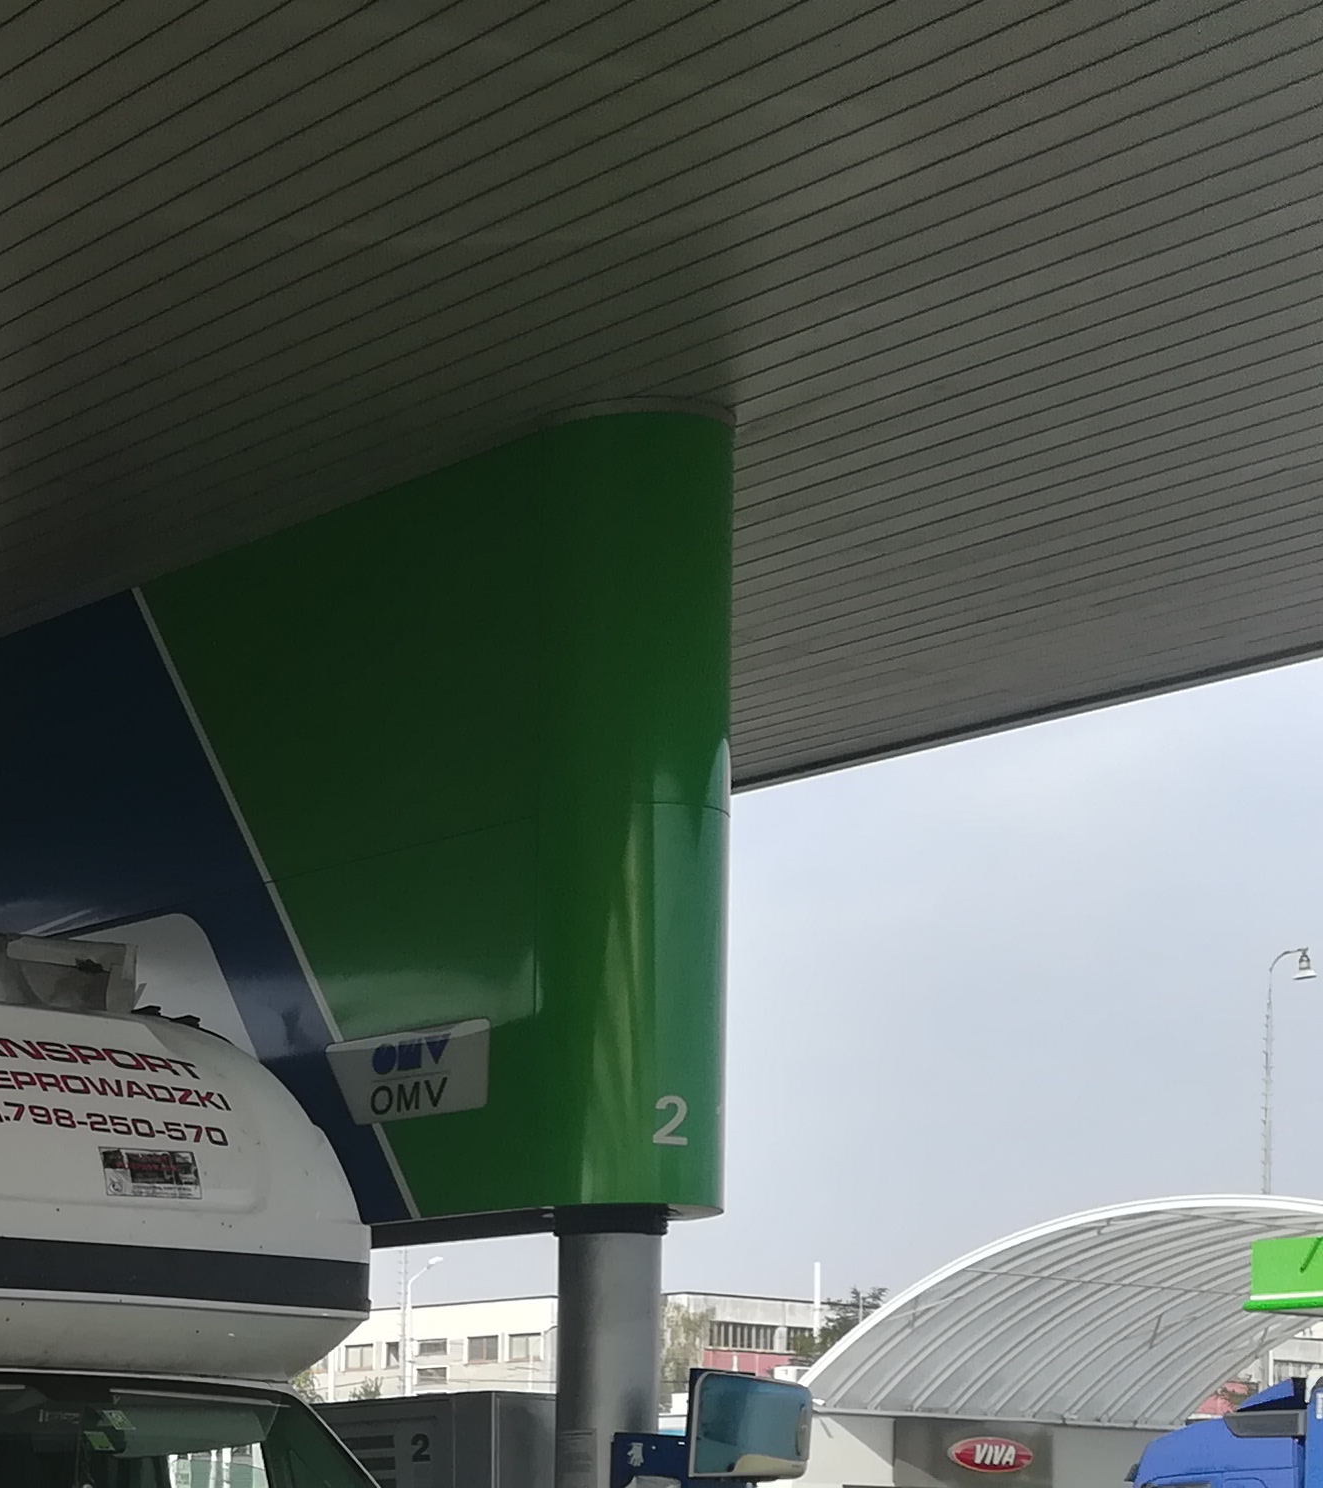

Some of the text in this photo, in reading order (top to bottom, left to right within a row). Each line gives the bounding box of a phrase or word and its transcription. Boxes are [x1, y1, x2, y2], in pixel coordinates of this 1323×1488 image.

[370, 1076, 448, 1115] OMV
[652, 1095, 688, 1146] 2
[410, 1433, 431, 1462] 2
[974, 1443, 1016, 1466] VIVA
